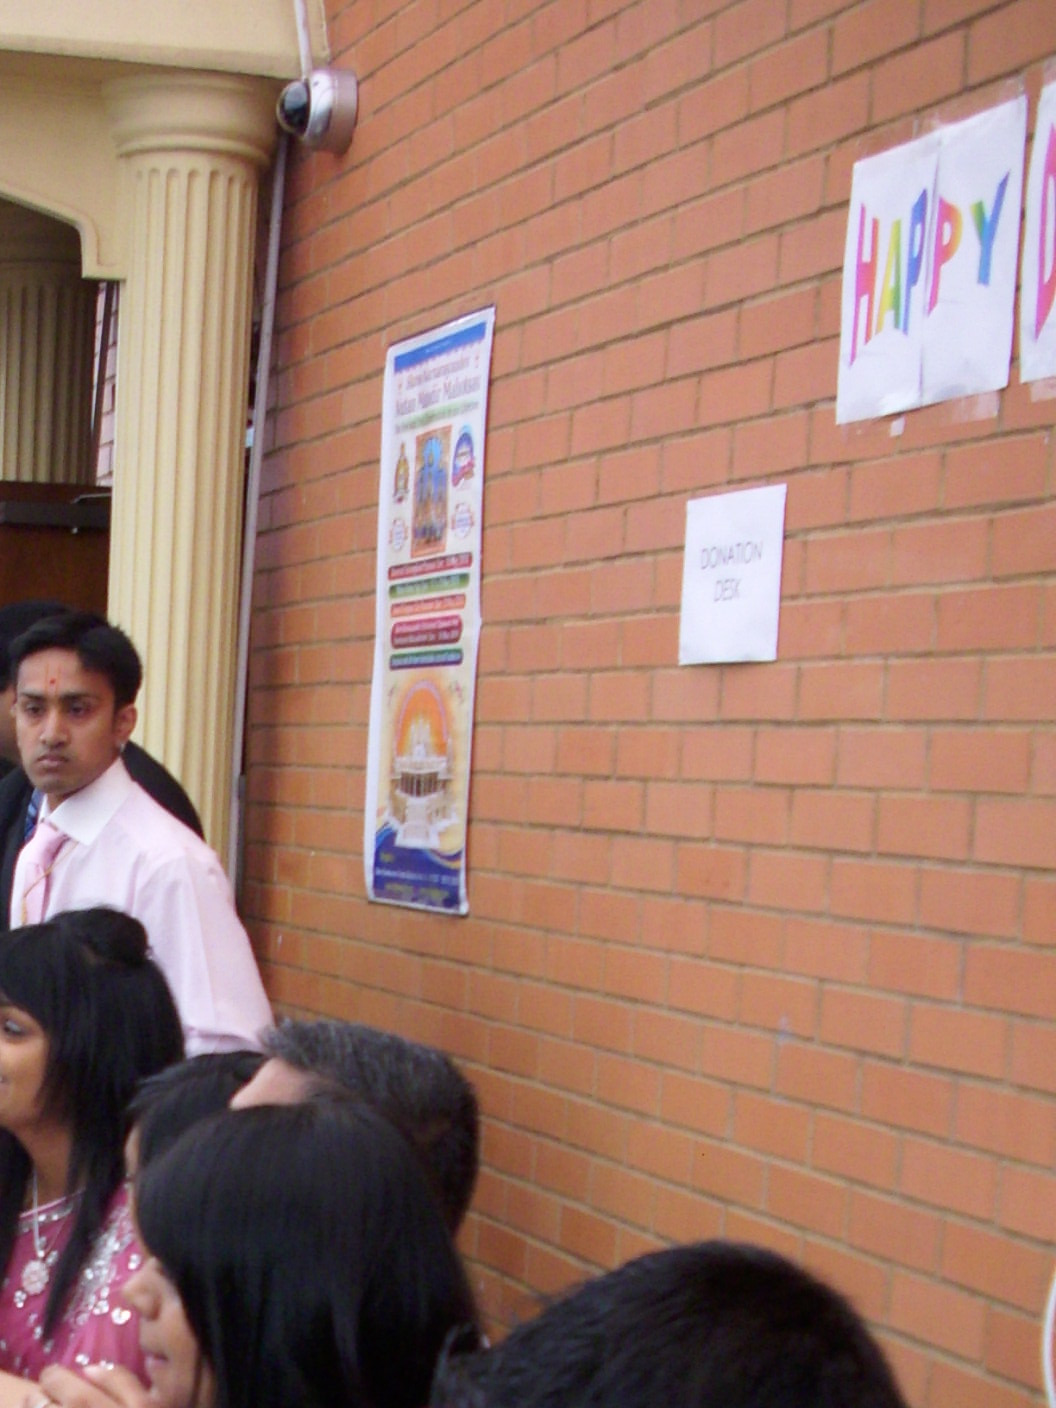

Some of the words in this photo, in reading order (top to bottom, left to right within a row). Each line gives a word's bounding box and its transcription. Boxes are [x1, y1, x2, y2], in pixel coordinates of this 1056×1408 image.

[849, 169, 1010, 368] HAPPY
[700, 541, 763, 570] DONATION
[713, 578, 742, 602] DESK
